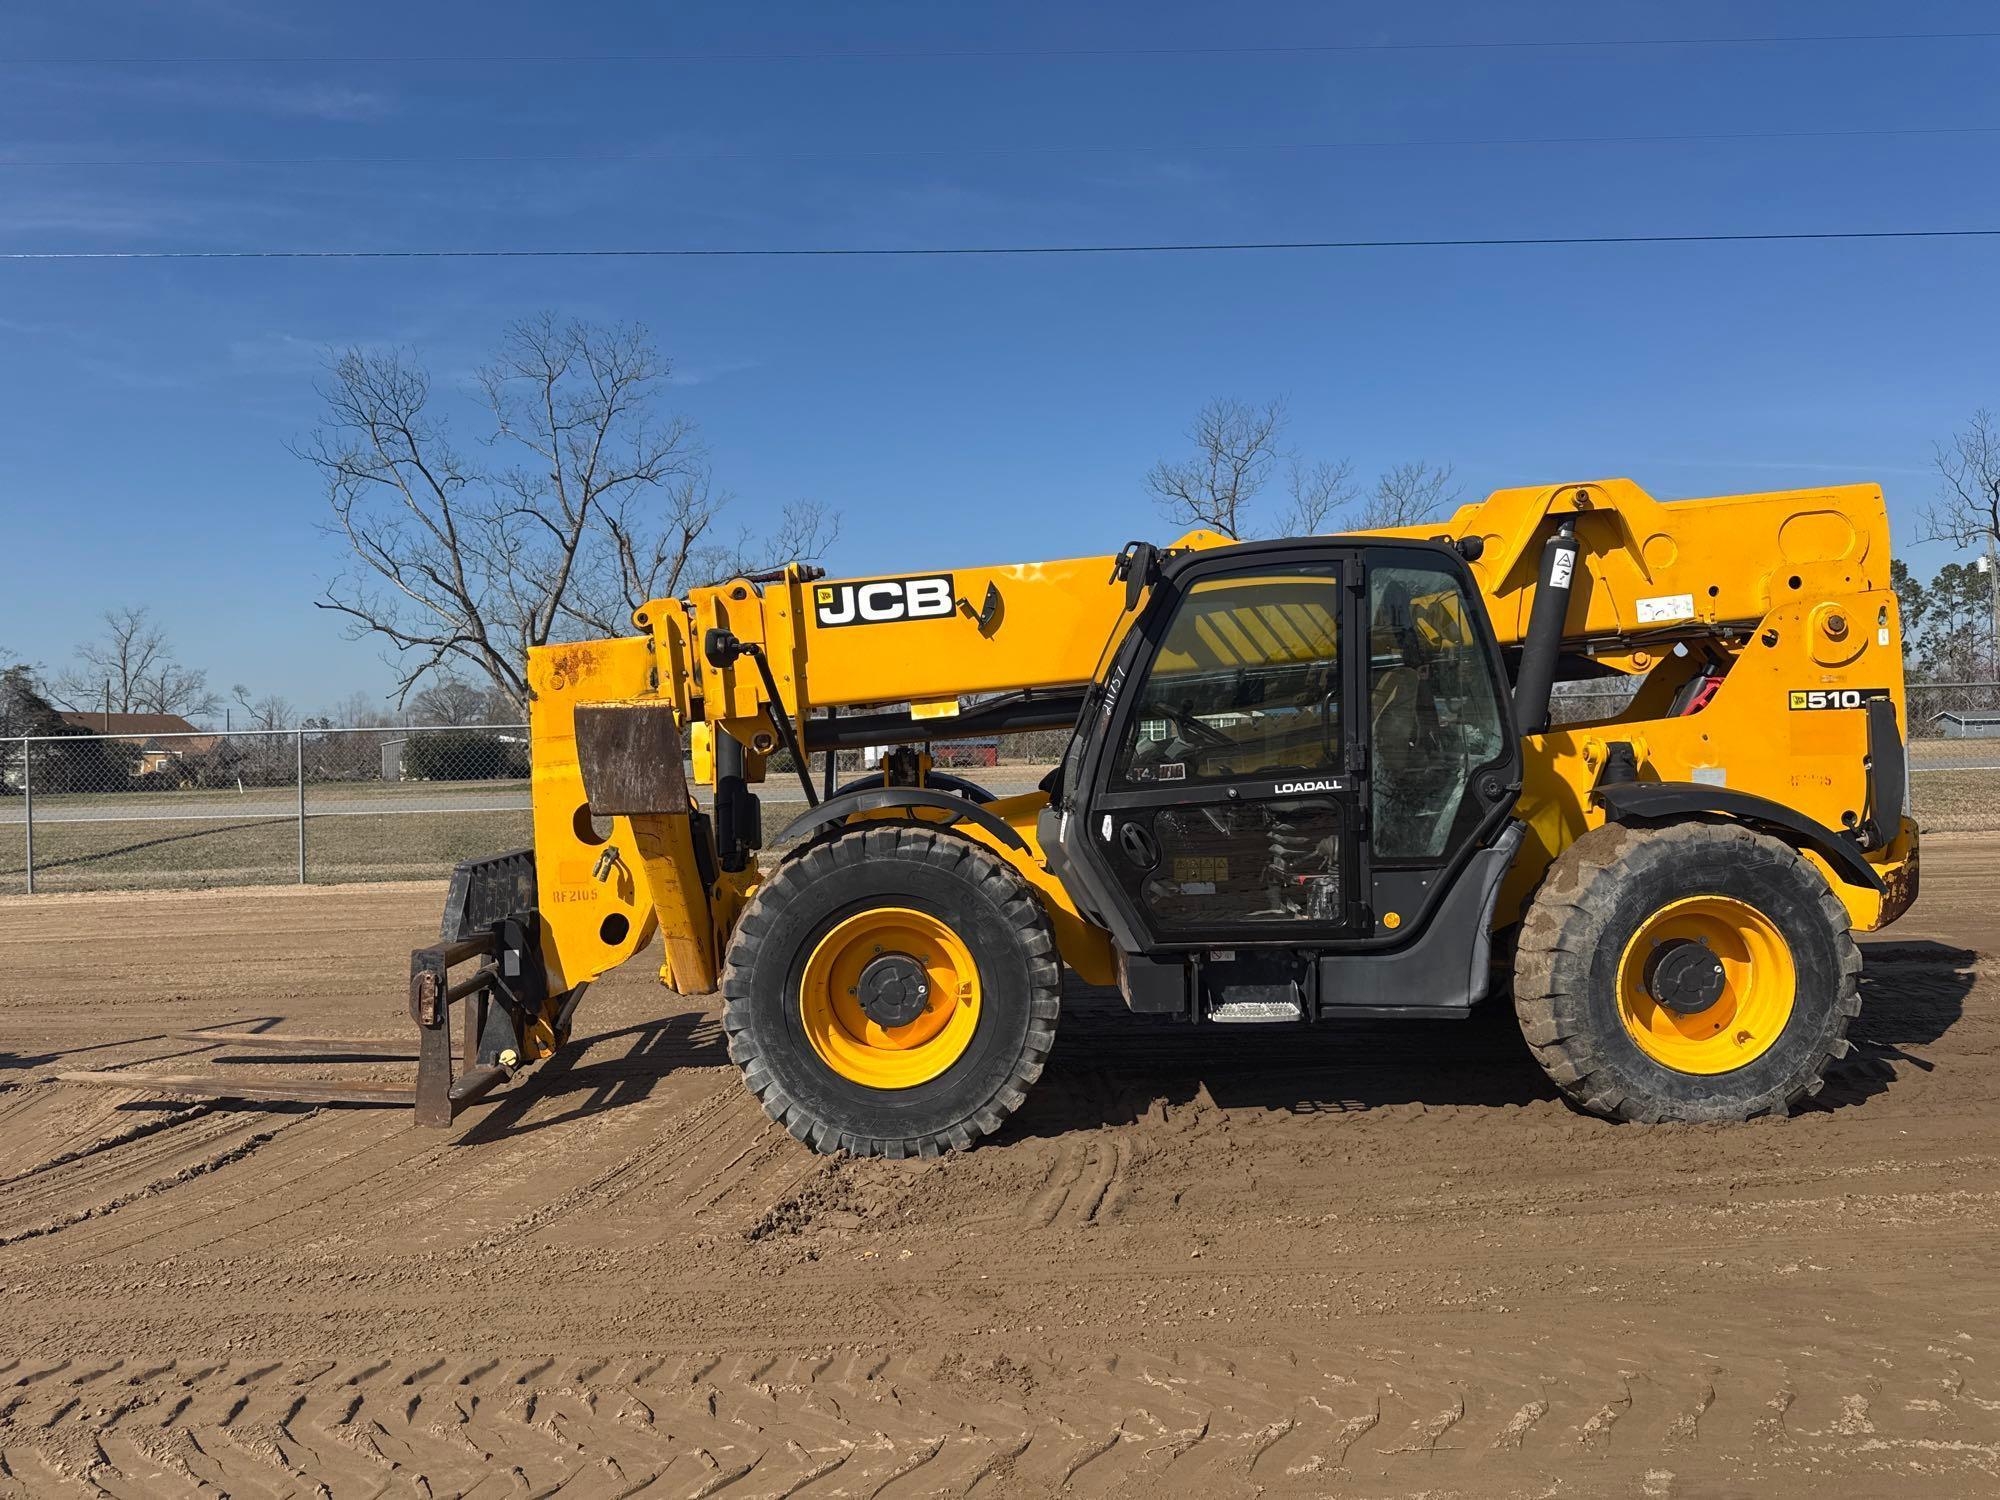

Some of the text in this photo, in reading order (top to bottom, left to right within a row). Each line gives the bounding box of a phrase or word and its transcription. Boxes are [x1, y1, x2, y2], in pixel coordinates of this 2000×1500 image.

[819, 578, 953, 624] JCB
[1102, 665, 1126, 716] 211757
[1274, 780, 1342, 794] LOADALL
